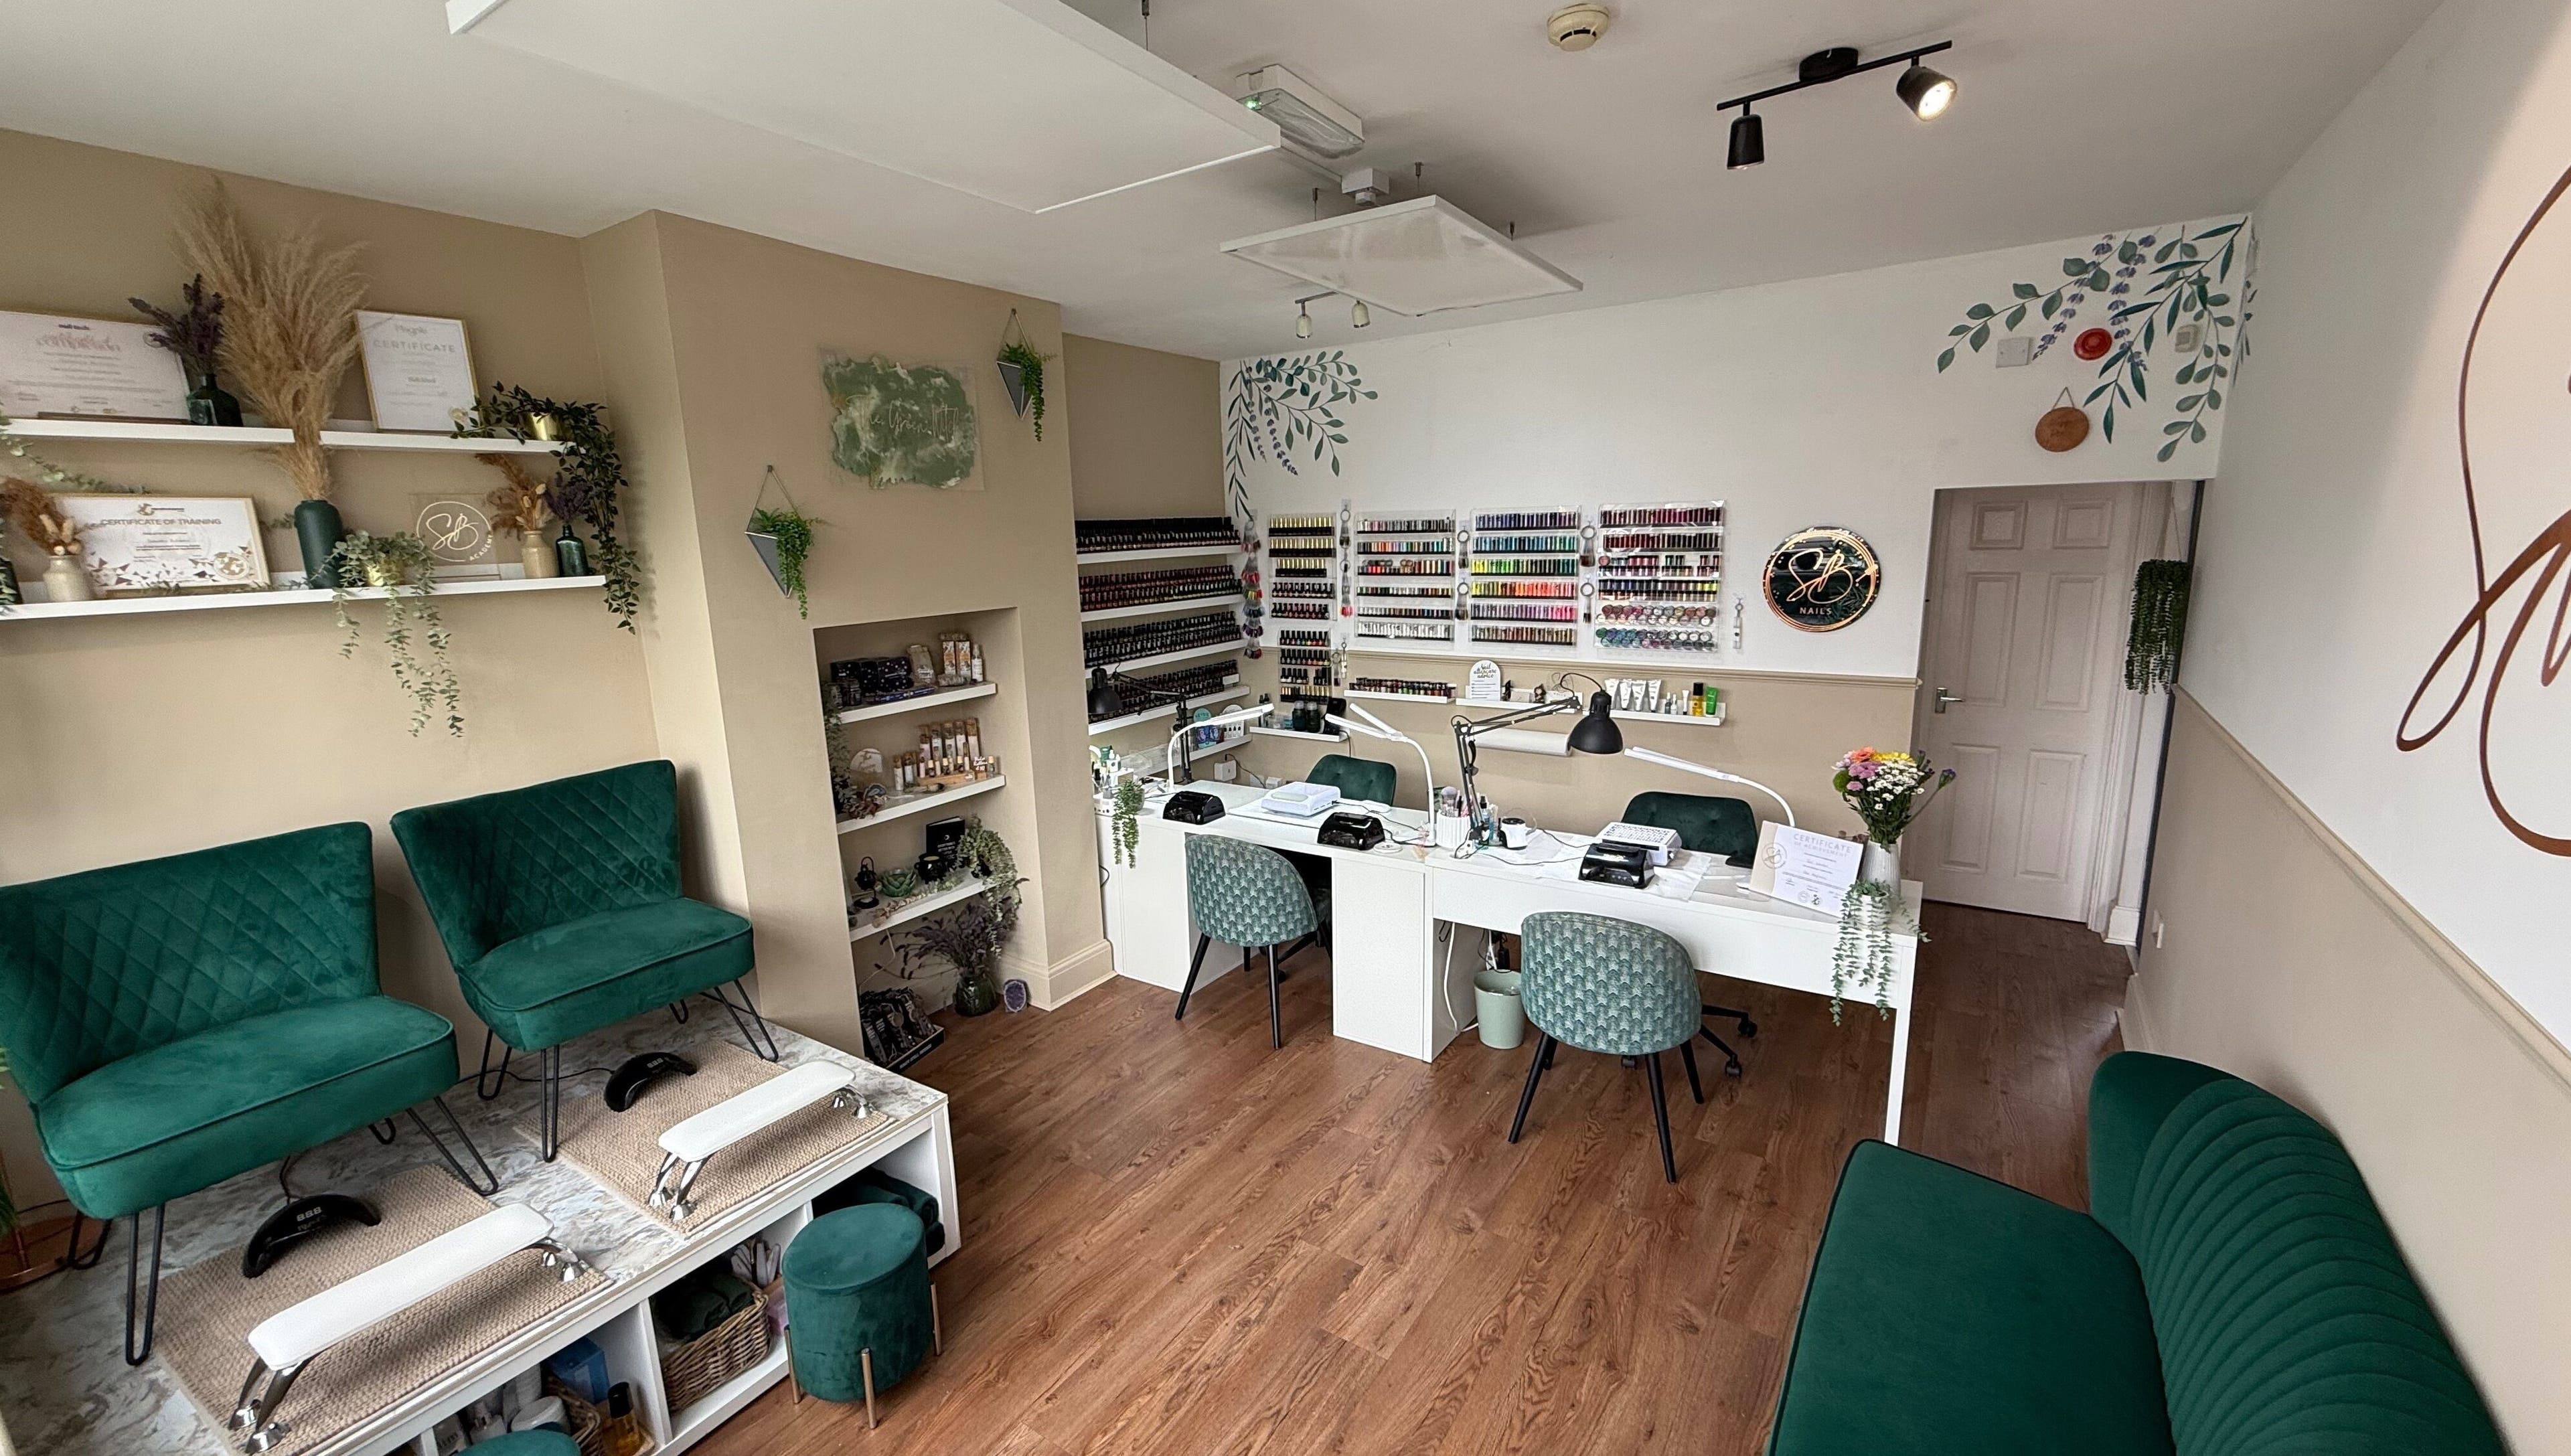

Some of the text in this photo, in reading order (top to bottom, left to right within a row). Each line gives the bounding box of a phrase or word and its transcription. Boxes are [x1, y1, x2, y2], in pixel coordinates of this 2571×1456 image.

[373, 339, 456, 353] CERTIFICATE
[469, 534, 493, 562] ACADEMY
[1800, 606, 1833, 615] NAILS
[1794, 833, 1853, 854] CERTIFICATE
